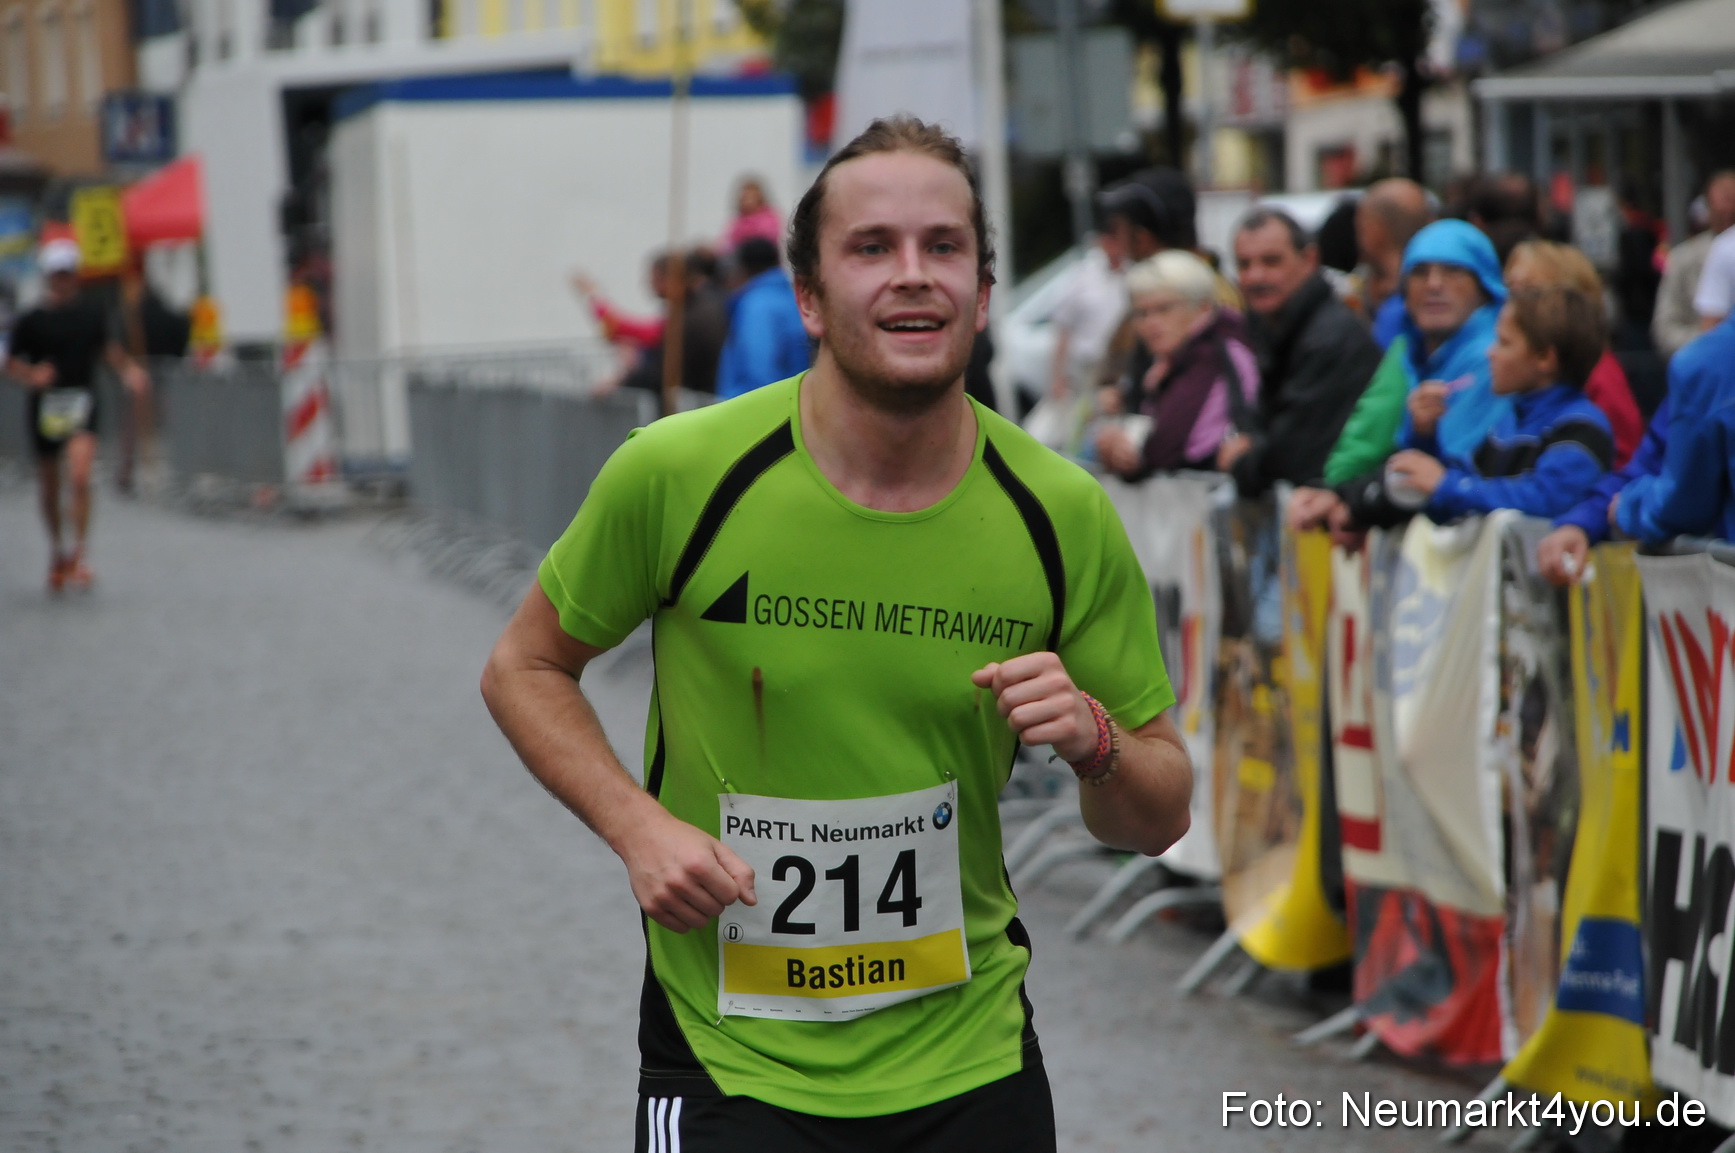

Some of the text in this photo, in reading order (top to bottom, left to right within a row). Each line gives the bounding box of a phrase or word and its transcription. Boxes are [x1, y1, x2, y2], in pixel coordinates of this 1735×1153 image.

[754, 593, 1035, 651] GOSSEN METRAWATT
[726, 815, 925, 843] PARTL Neumarkt
[771, 848, 923, 935] 214
[786, 954, 906, 990] Bastian
